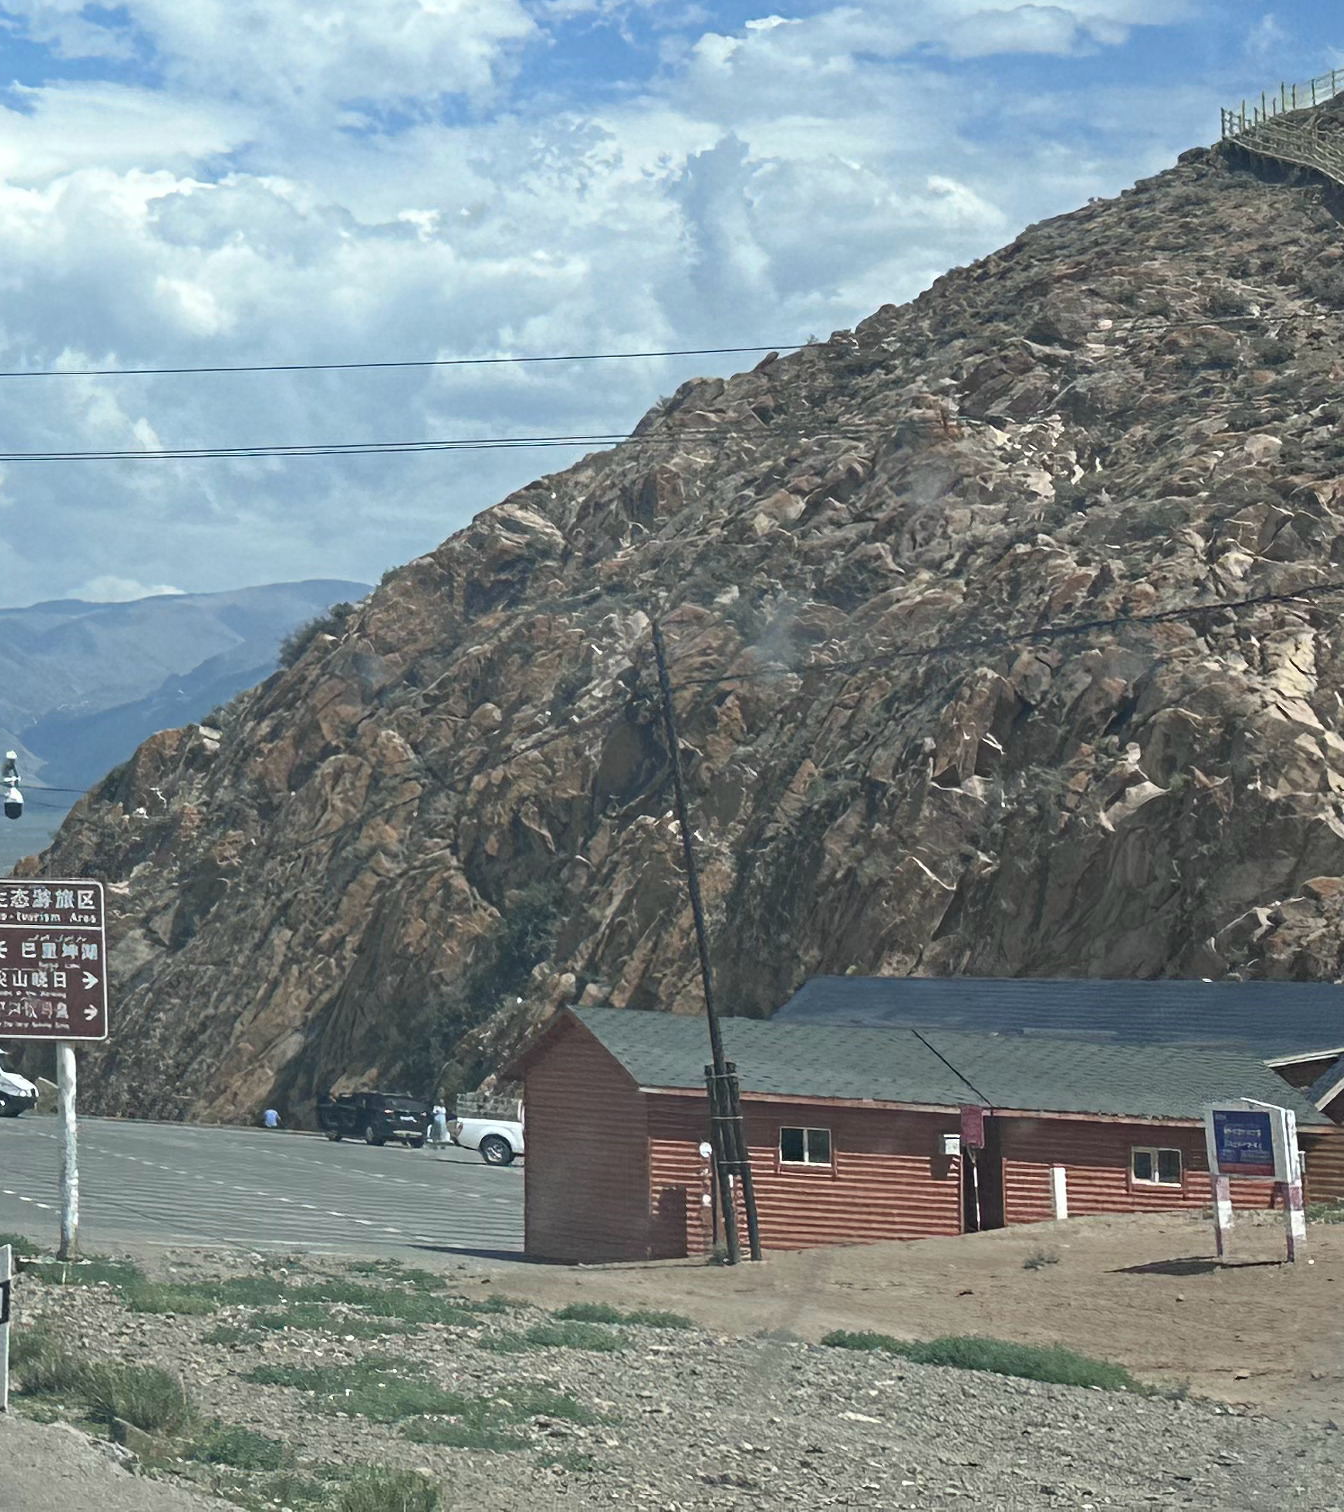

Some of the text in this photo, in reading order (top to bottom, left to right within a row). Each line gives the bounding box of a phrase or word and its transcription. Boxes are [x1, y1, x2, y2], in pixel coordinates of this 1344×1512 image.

[69, 912, 97, 924] Area
[21, 942, 98, 960] 巴里坤湖
